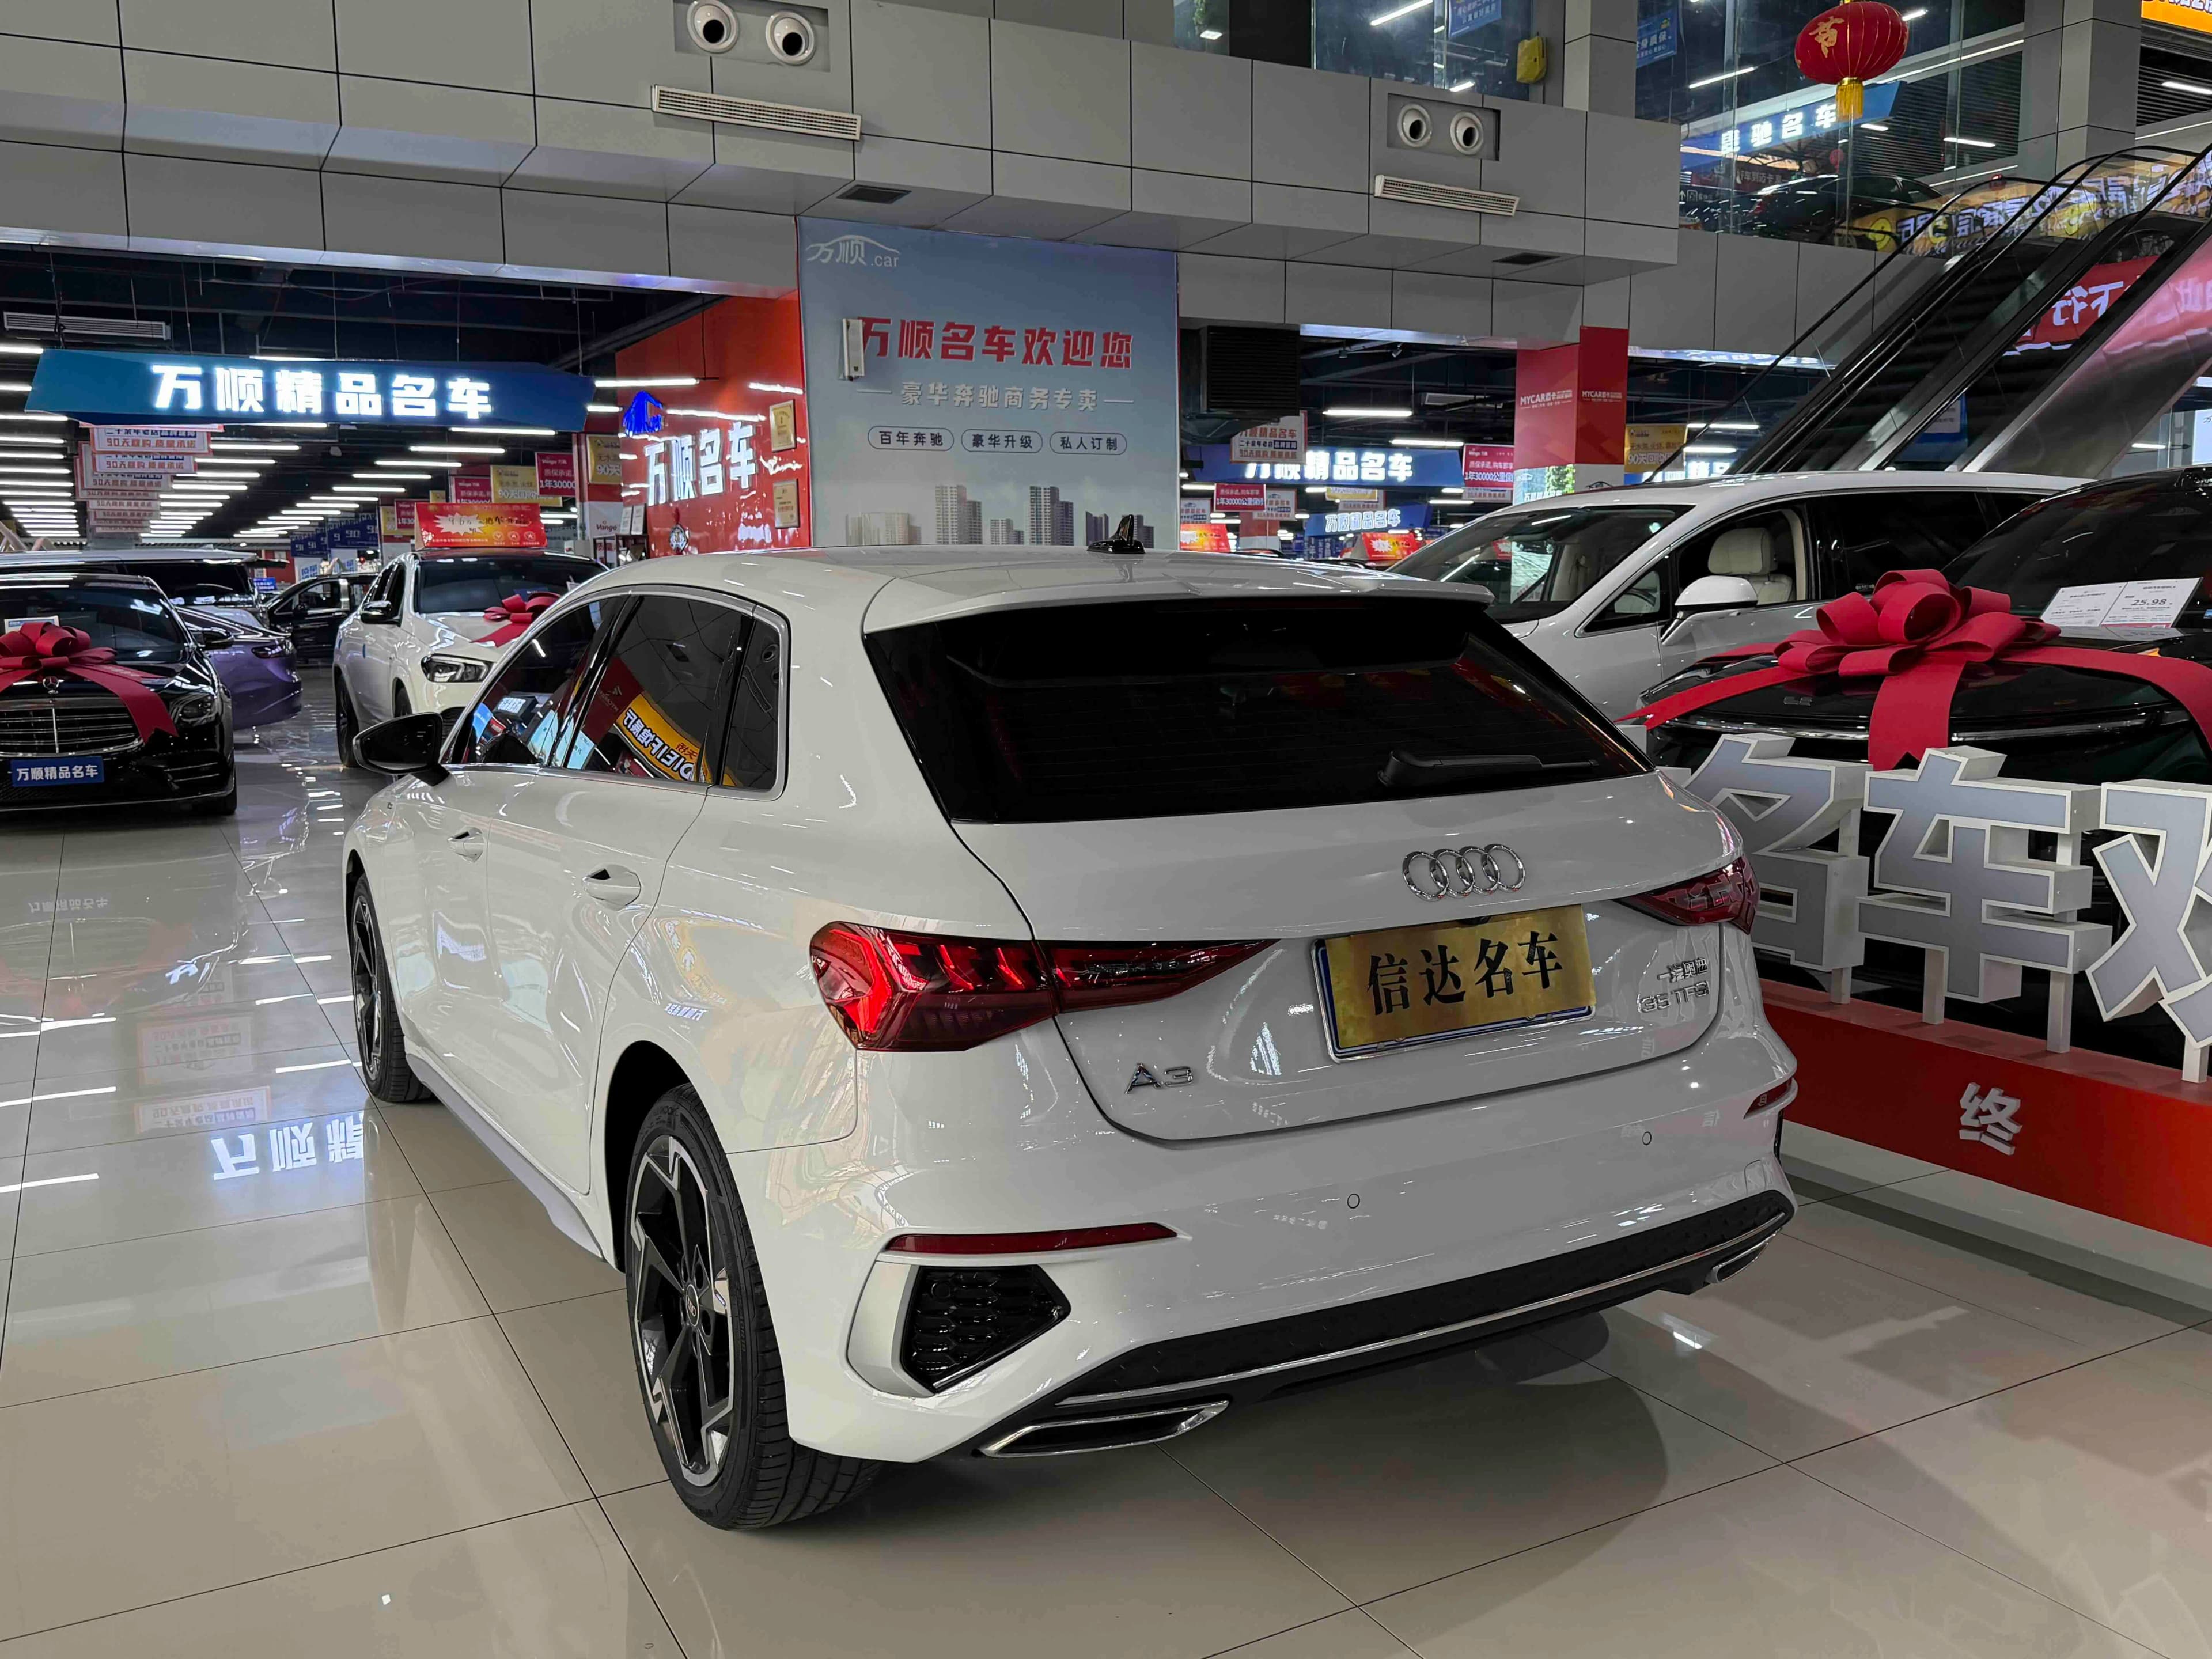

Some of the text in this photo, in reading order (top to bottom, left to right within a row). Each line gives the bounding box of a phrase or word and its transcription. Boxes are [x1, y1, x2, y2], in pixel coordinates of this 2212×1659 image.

[858, 316, 1134, 369] 万顺名车欢迎您
[151, 364, 492, 419] 万顺精品名车
[900, 381, 1099, 412] 豪华奔驰商务专卖
[878, 430, 944, 447] 百年奔驰
[971, 434, 1033, 449] 豪华升级
[1060, 436, 1118, 451] 私人订制
[644, 421, 756, 507] 万顺名车
[1244, 450, 1414, 483] 万顺精品名车
[16, 763, 99, 781] 万顺精品名车
[1366, 931, 1563, 1017] 信达名车
[1638, 993, 1671, 1013] 35
[1124, 1062, 1194, 1094] A3
